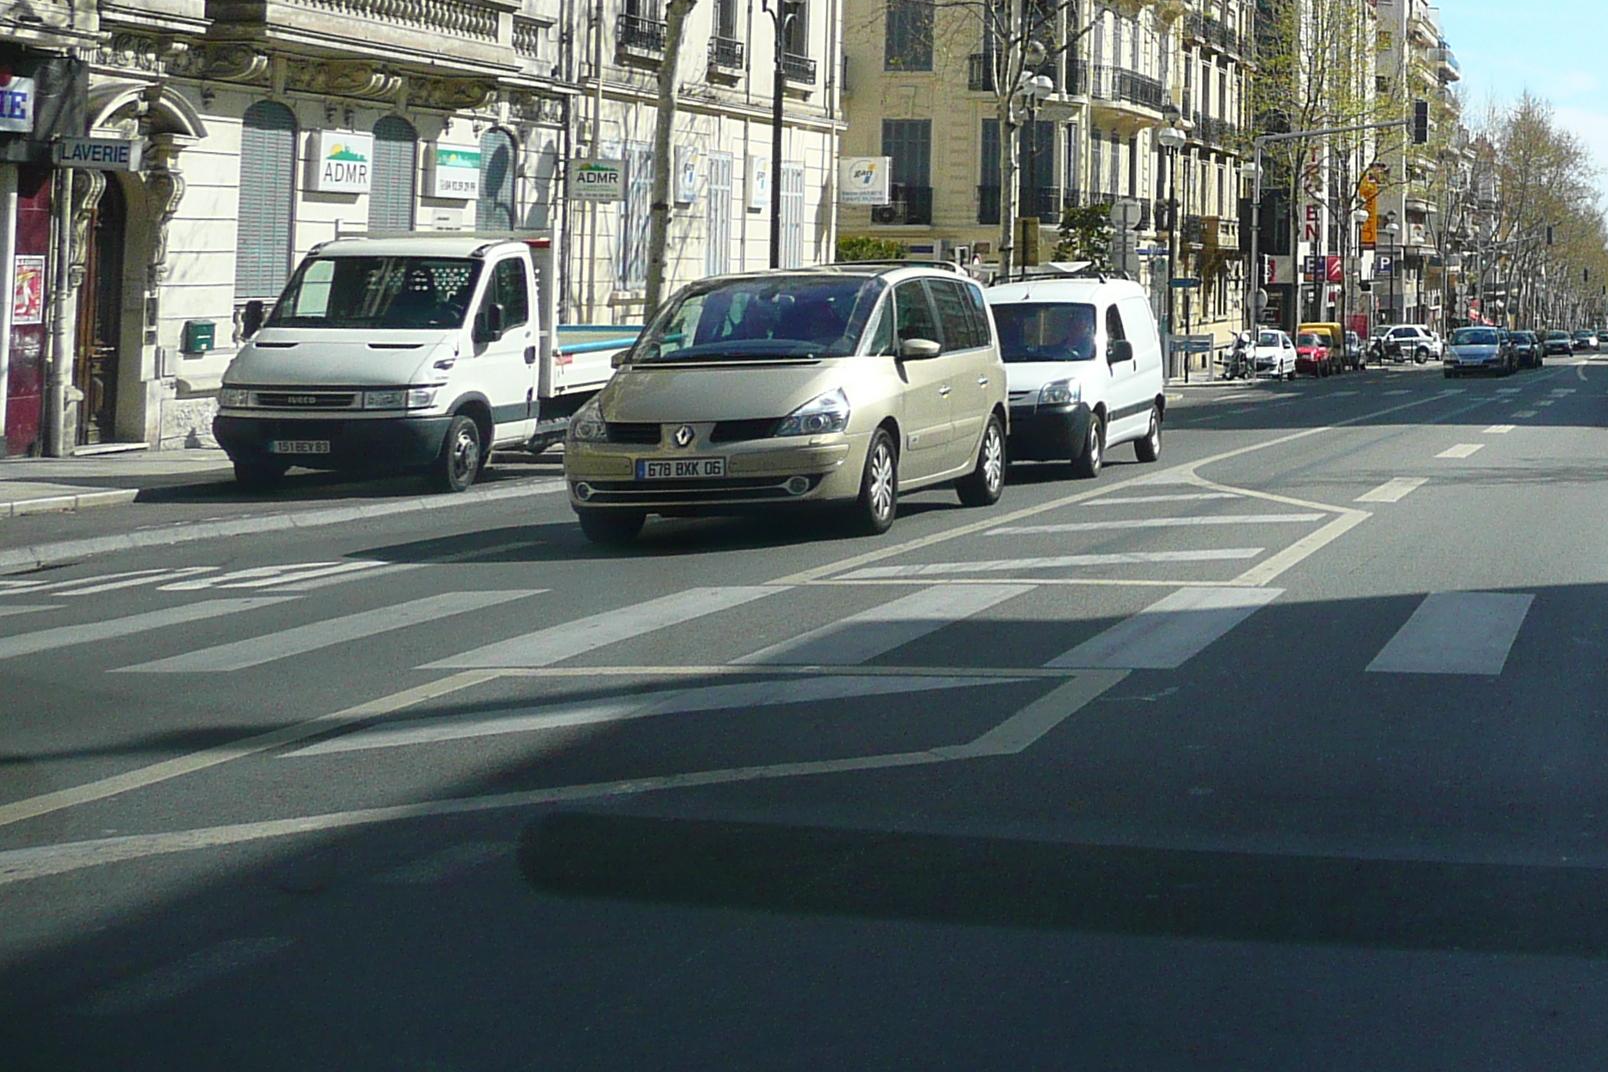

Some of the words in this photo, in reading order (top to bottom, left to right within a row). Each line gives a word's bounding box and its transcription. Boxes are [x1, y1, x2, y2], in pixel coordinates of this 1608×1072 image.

[61, 144, 129, 163] LAVERIE
[324, 163, 367, 184] ADMR
[576, 172, 619, 184] ADMR
[648, 463, 671, 477] 678
[676, 462, 700, 476] BXK
[704, 461, 721, 474] 06
